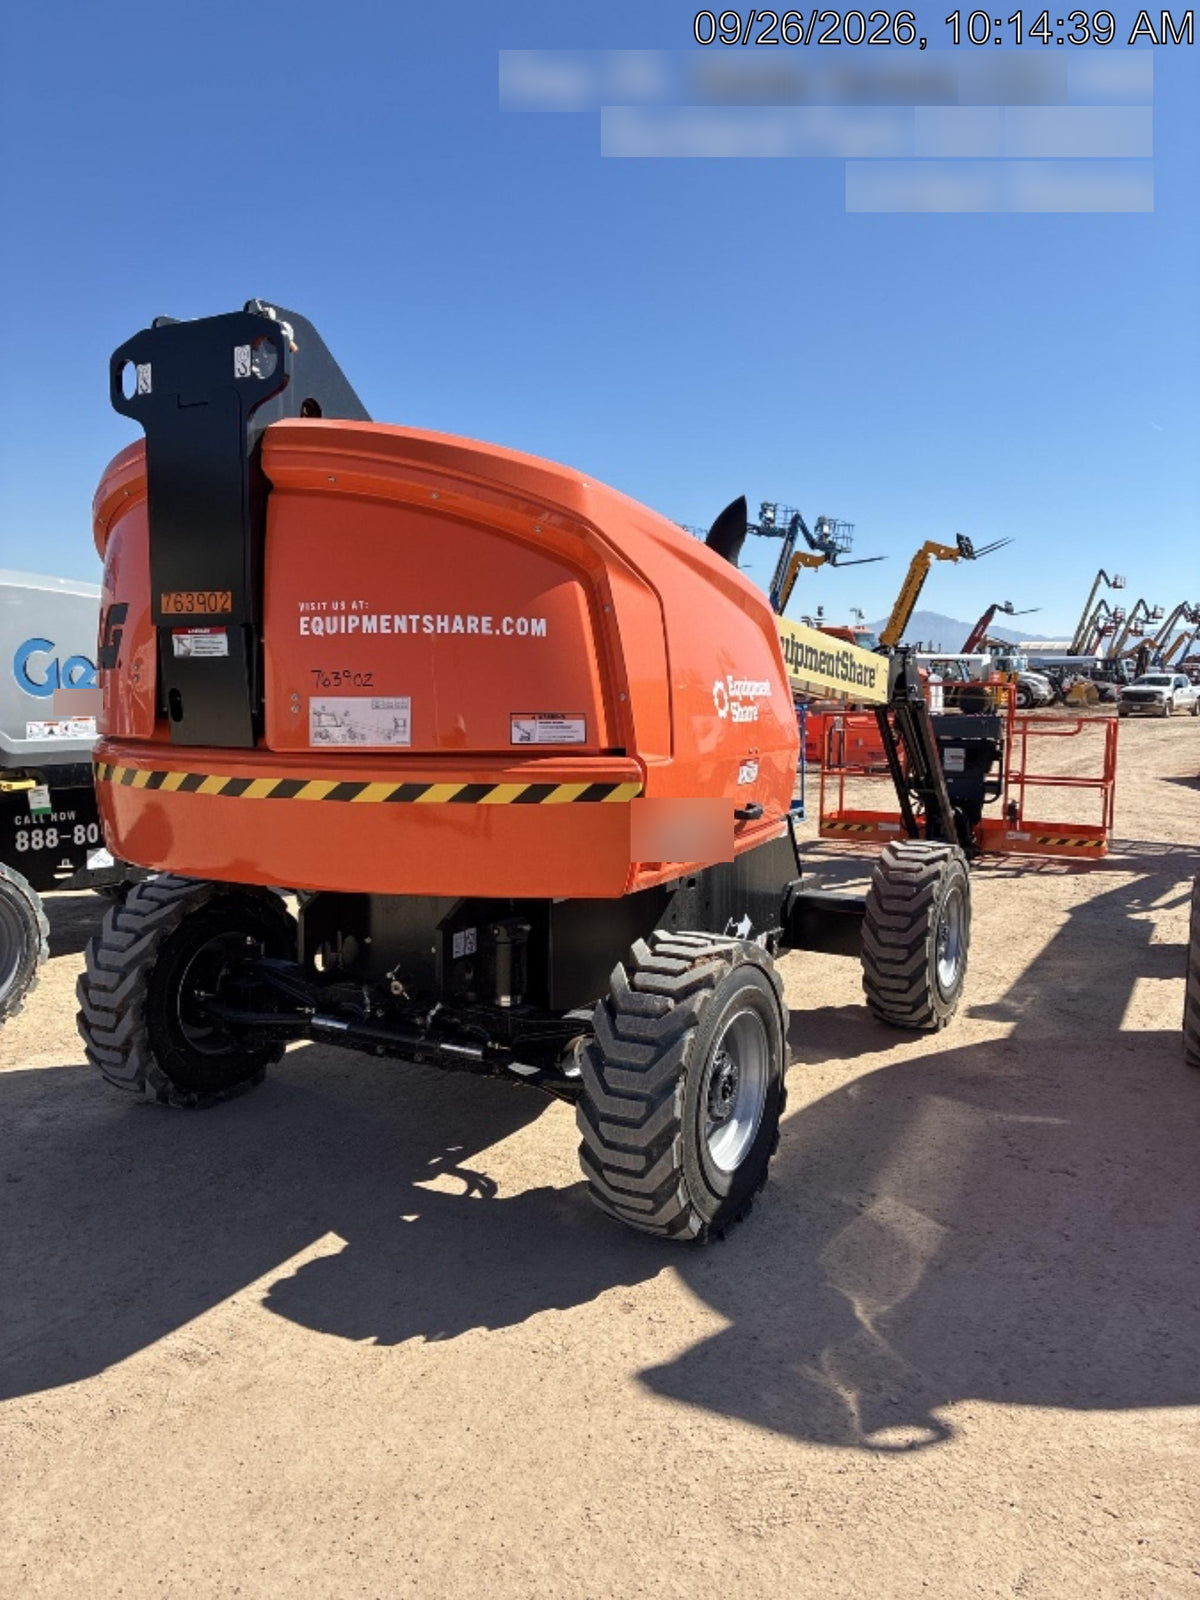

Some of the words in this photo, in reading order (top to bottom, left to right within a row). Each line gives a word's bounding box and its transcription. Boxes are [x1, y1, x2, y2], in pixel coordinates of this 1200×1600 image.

[163, 591, 231, 612] 763902
[298, 601, 328, 612] VISIT
[331, 601, 347, 611] US
[351, 600, 369, 611] AT:
[299, 614, 548, 638] EQUIPMENTSHARE.COM
[13, 637, 99, 699] Ge
[780, 632, 877, 689] uipmentShare
[311, 669, 375, 689] 763902
[50, 810, 77, 823] NOW
[15, 822, 99, 852] 888-80
